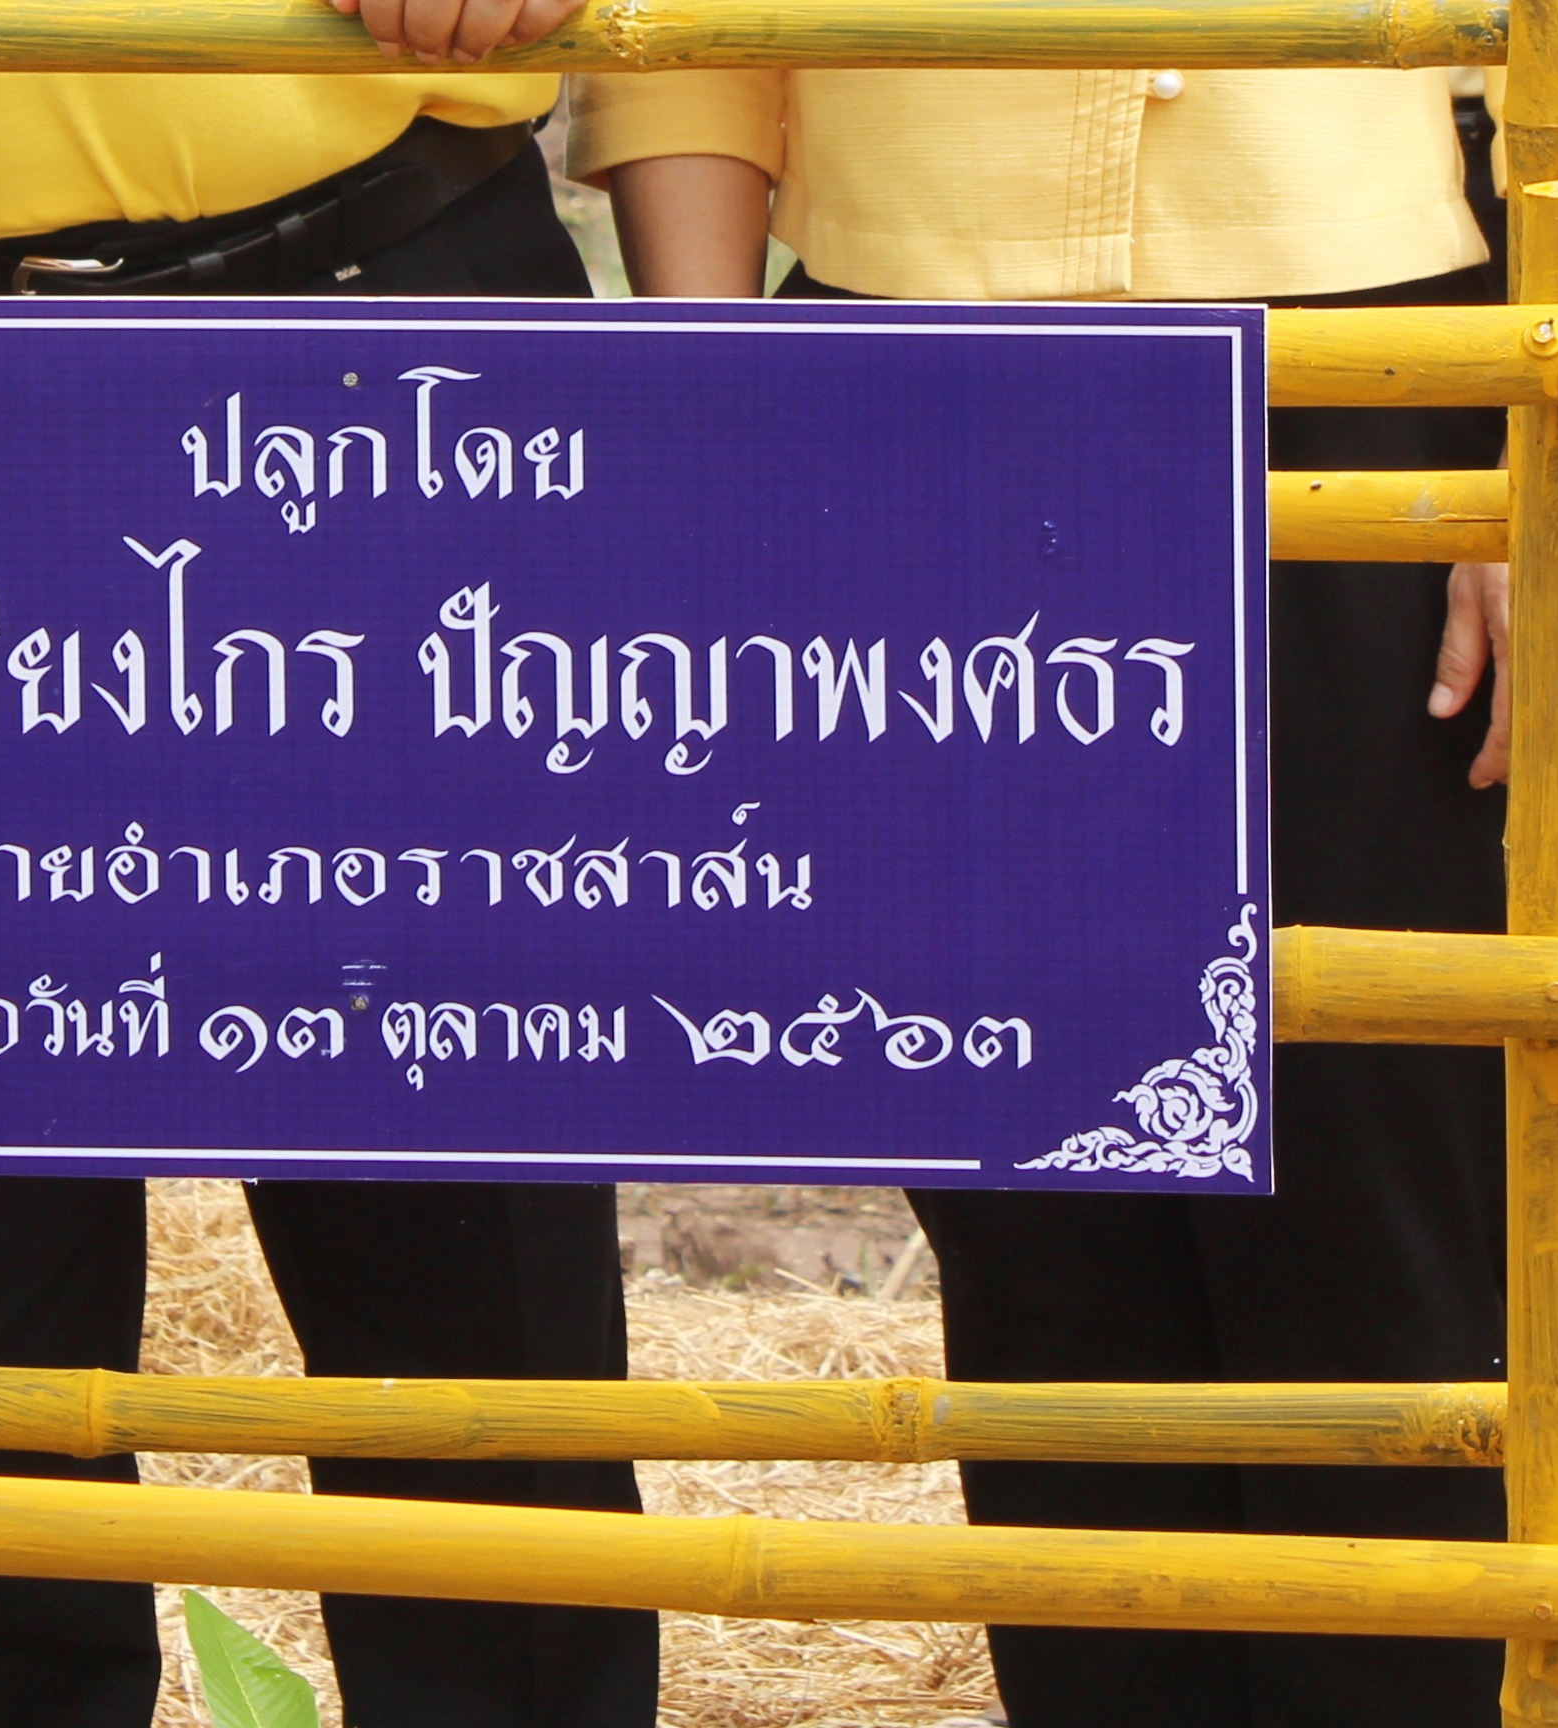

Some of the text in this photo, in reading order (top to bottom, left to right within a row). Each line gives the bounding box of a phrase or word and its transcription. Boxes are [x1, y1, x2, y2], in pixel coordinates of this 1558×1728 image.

[181, 366, 585, 535] ปลูกโดย
[417, 580, 1195, 776] ปัญญาพงศธร
[199, 1005, 345, 1073] ๑๓
[381, 1001, 626, 1091] ตุลาคม
[651, 987, 1032, 1070] ๒๕๖๓
